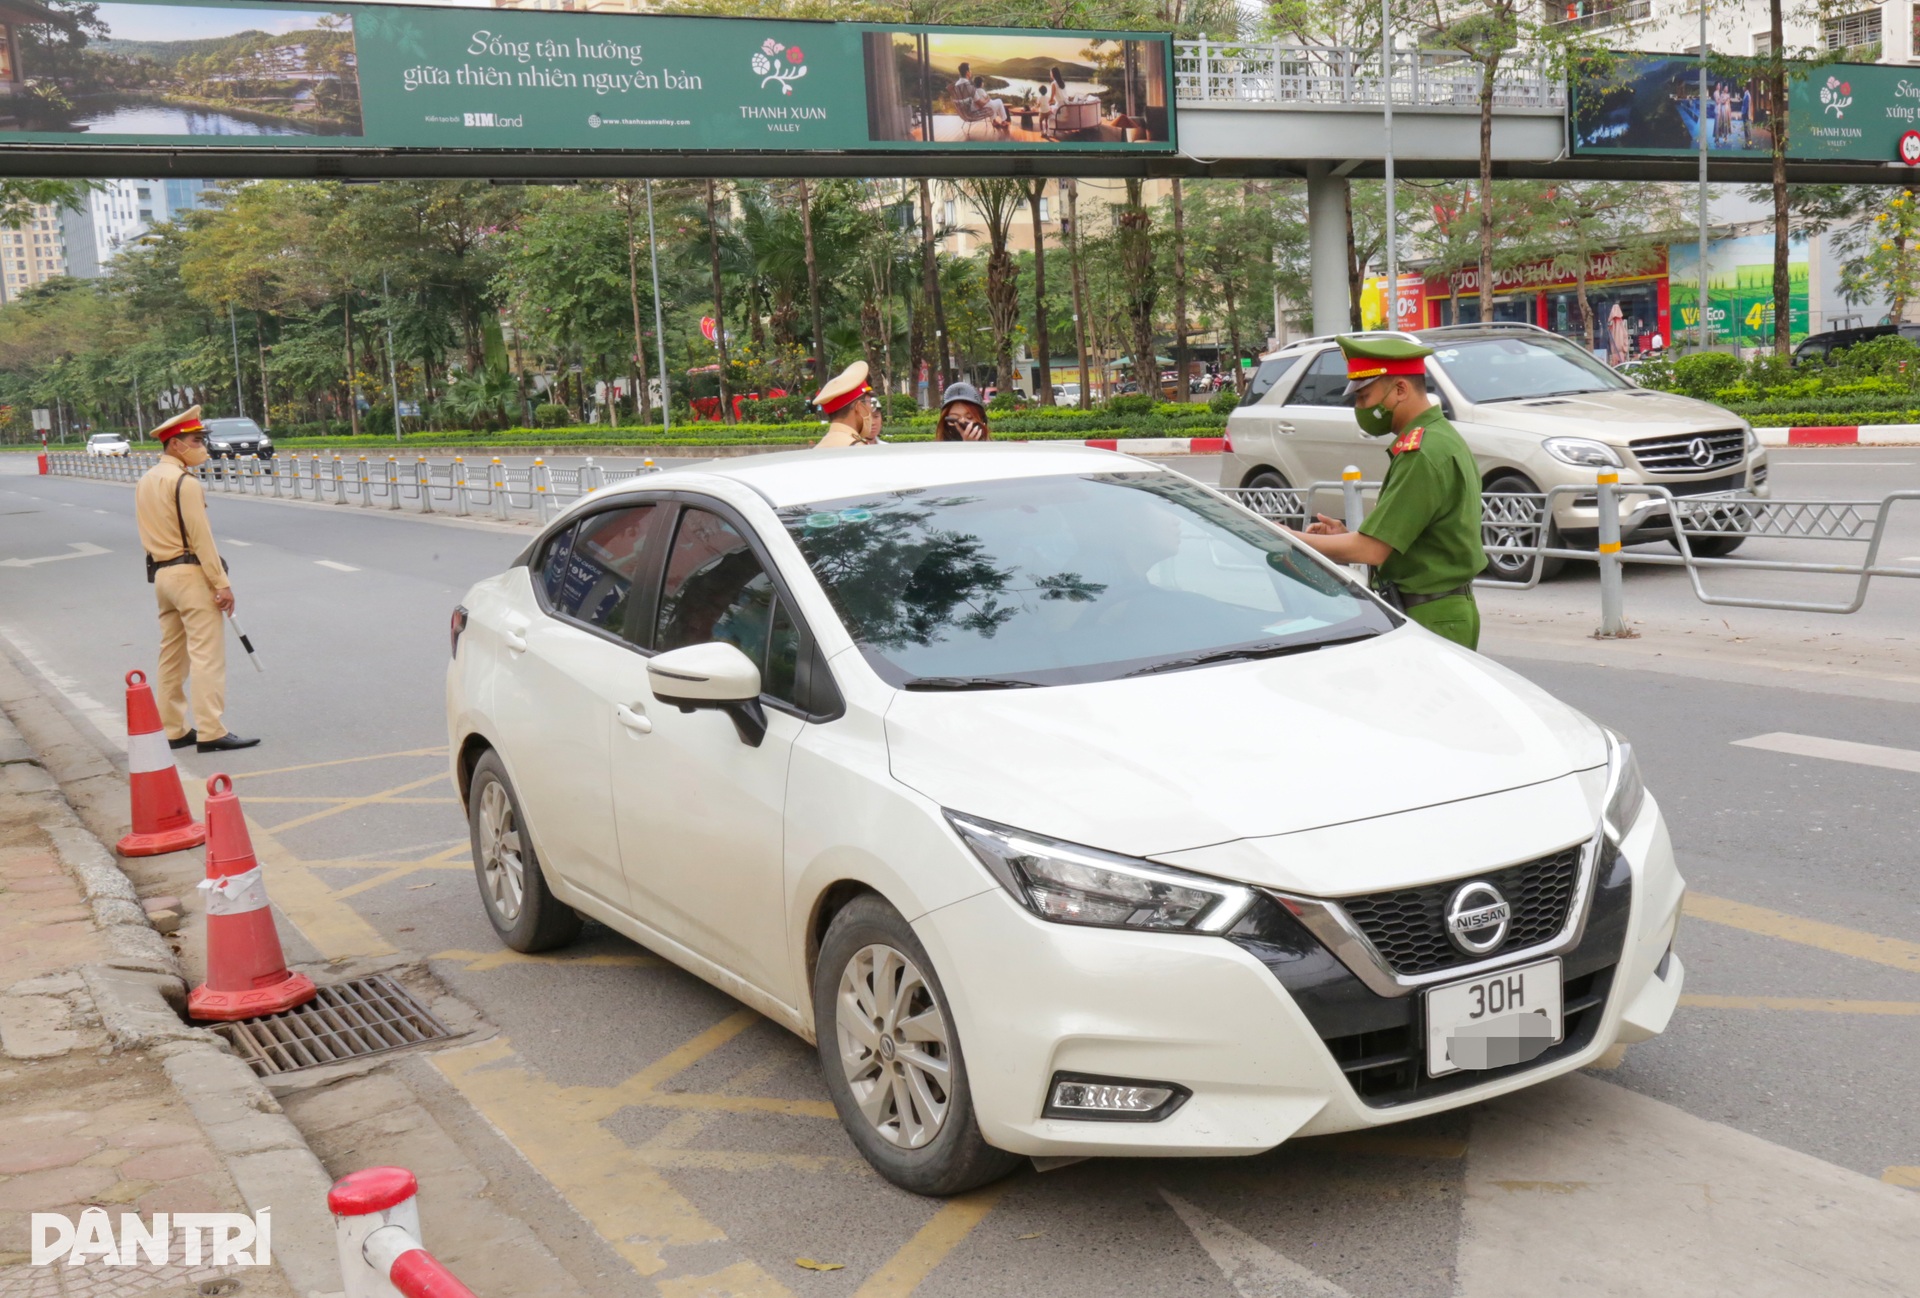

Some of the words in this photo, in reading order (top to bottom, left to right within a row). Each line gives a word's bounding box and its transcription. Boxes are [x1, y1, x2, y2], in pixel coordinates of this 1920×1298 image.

[467, 30, 531, 63] Sống
[536, 39, 570, 62] tận
[576, 38, 643, 66] hưởng
[404, 65, 451, 91] giữa
[456, 63, 512, 86] thiên
[518, 65, 577, 88] nhiên
[583, 70, 659, 95] nguyên
[664, 68, 703, 90] bản
[602, 118, 691, 127] www.thanhxuanvalley.com
[739, 106, 787, 119] THANH
[791, 107, 826, 120] XUAN
[1886, 103, 1915, 123] xứng
[767, 123, 800, 132] VALLEY
[1810, 127, 1839, 137] THANH
[1841, 128, 1862, 138] XUAN
[1826, 139, 1847, 147] VALLEY
[1386, 297, 1417, 317] 0%
[1681, 307, 1725, 325] WiEco
[1745, 302, 1762, 330] 4
[1456, 909, 1506, 929] NISSAN
[1468, 973, 1525, 1019] 30H
